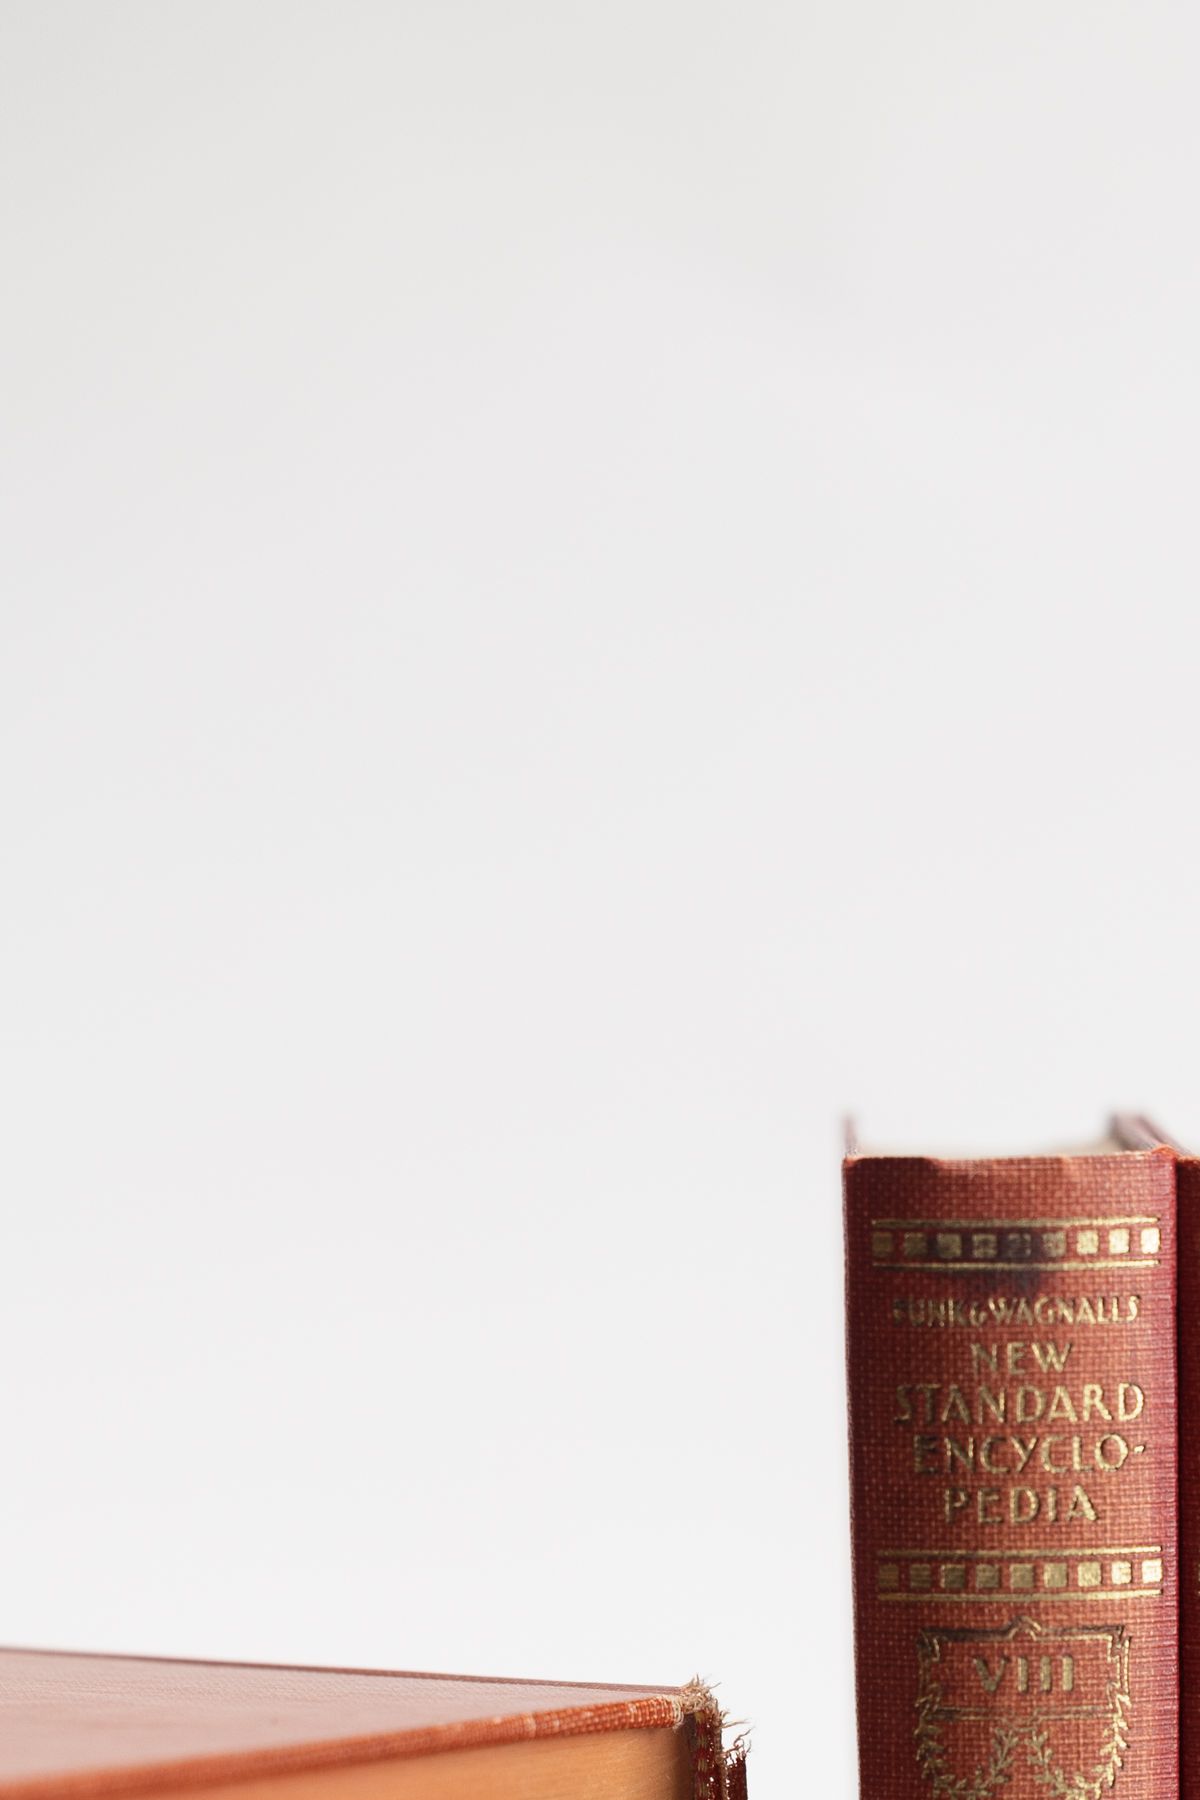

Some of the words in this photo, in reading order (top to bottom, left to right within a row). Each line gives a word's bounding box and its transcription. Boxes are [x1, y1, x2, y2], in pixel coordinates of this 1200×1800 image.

[970, 1341, 1073, 1376] NEW
[893, 1382, 1145, 1425] STANDARD
[912, 1432, 1146, 1475] ENCYCLO-
[943, 1484, 1100, 1525] PEDIA
[972, 1653, 1075, 1694] VIII
